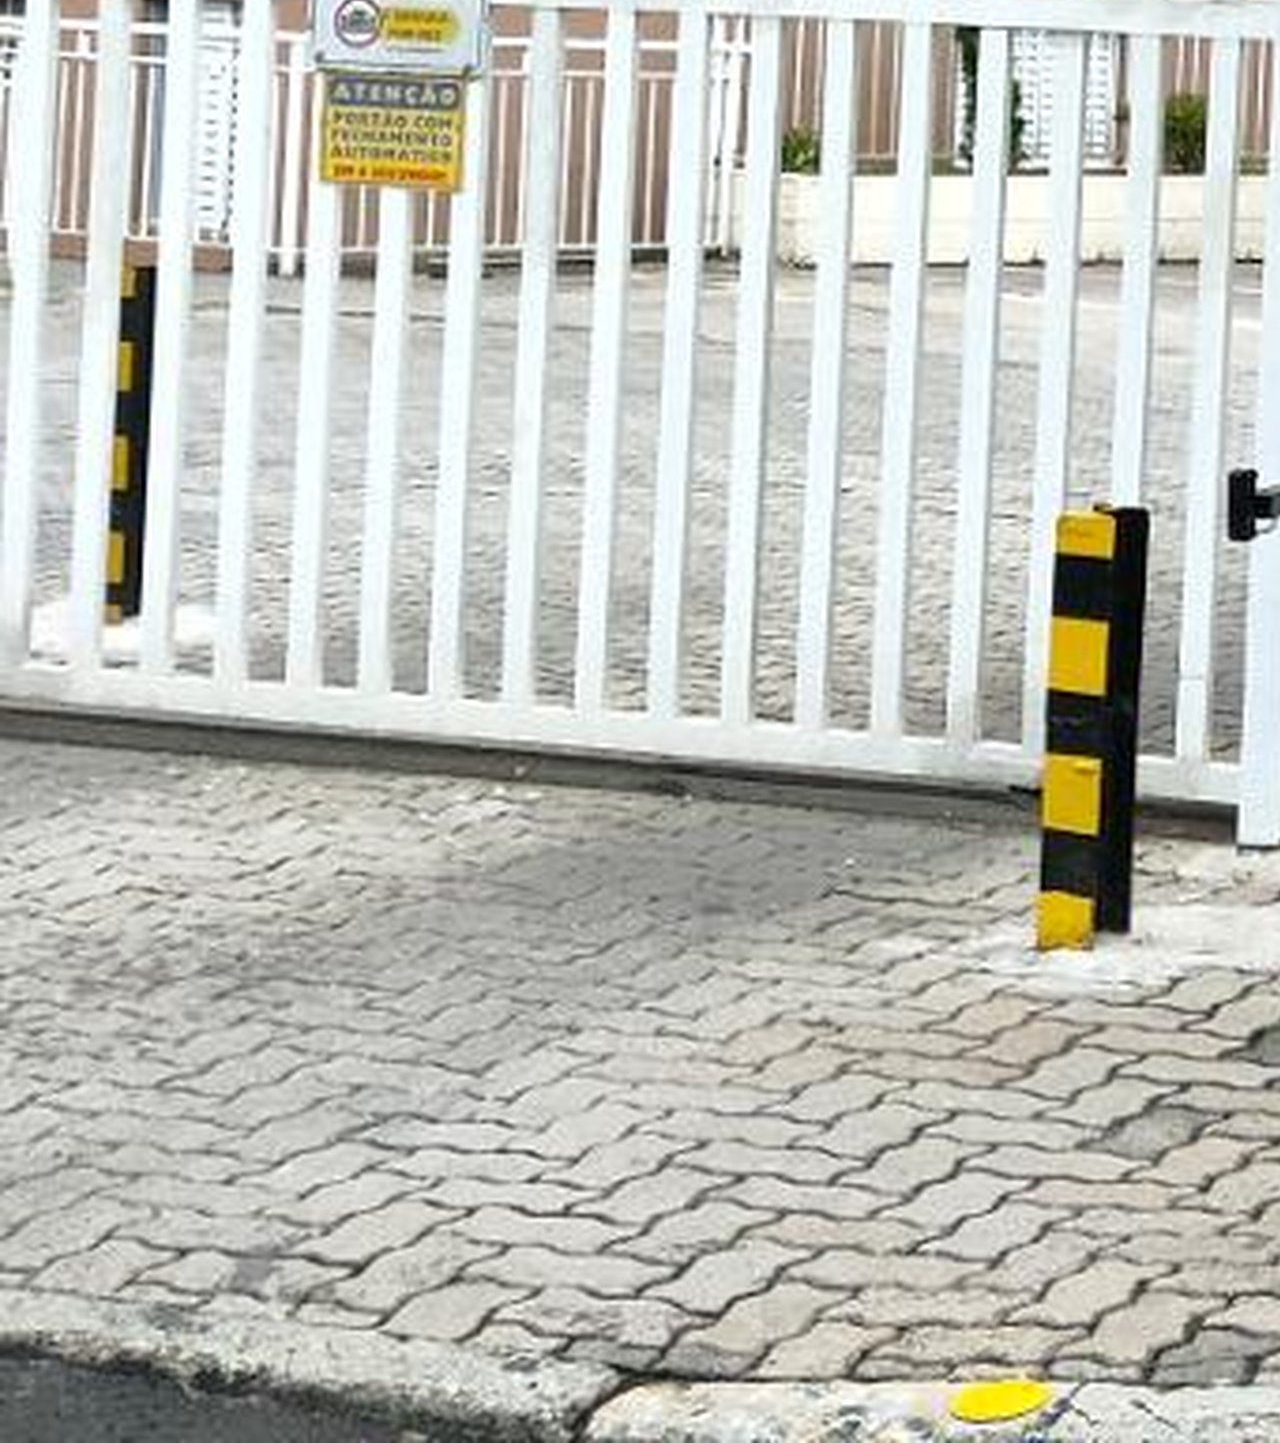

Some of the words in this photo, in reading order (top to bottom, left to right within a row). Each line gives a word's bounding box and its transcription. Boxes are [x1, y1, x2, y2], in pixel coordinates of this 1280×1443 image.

[332, 82, 457, 106] ATENÇÃO
[332, 110, 408, 129] PORTÃO
[412, 113, 453, 131] COM
[331, 128, 453, 148] FECHAMENTO
